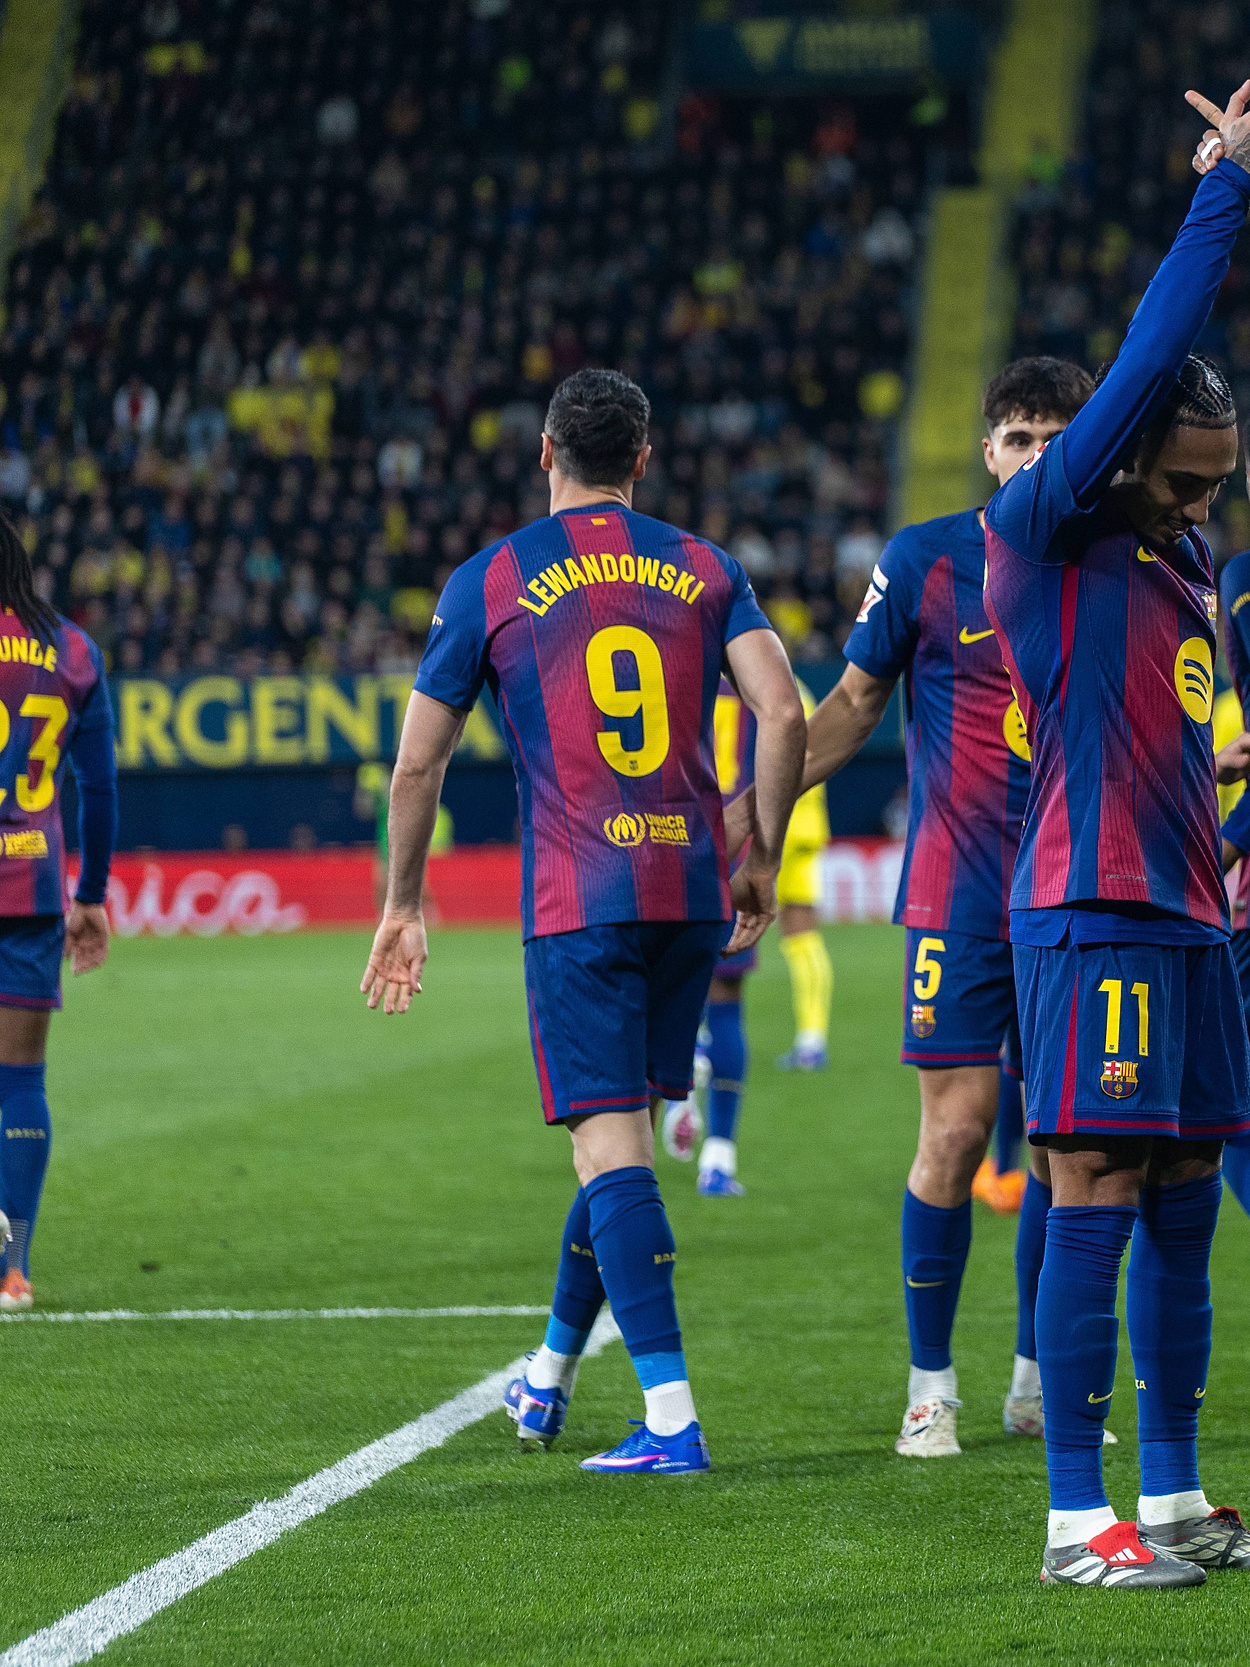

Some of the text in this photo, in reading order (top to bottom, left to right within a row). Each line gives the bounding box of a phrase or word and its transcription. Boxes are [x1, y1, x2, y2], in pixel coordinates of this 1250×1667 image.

[517, 553, 705, 617] LEWANDOWSKI
[0, 635, 58, 673] UNDE
[585, 624, 670, 778] 9
[914, 937, 946, 1000] 5
[1098, 979, 1149, 1056] 11
